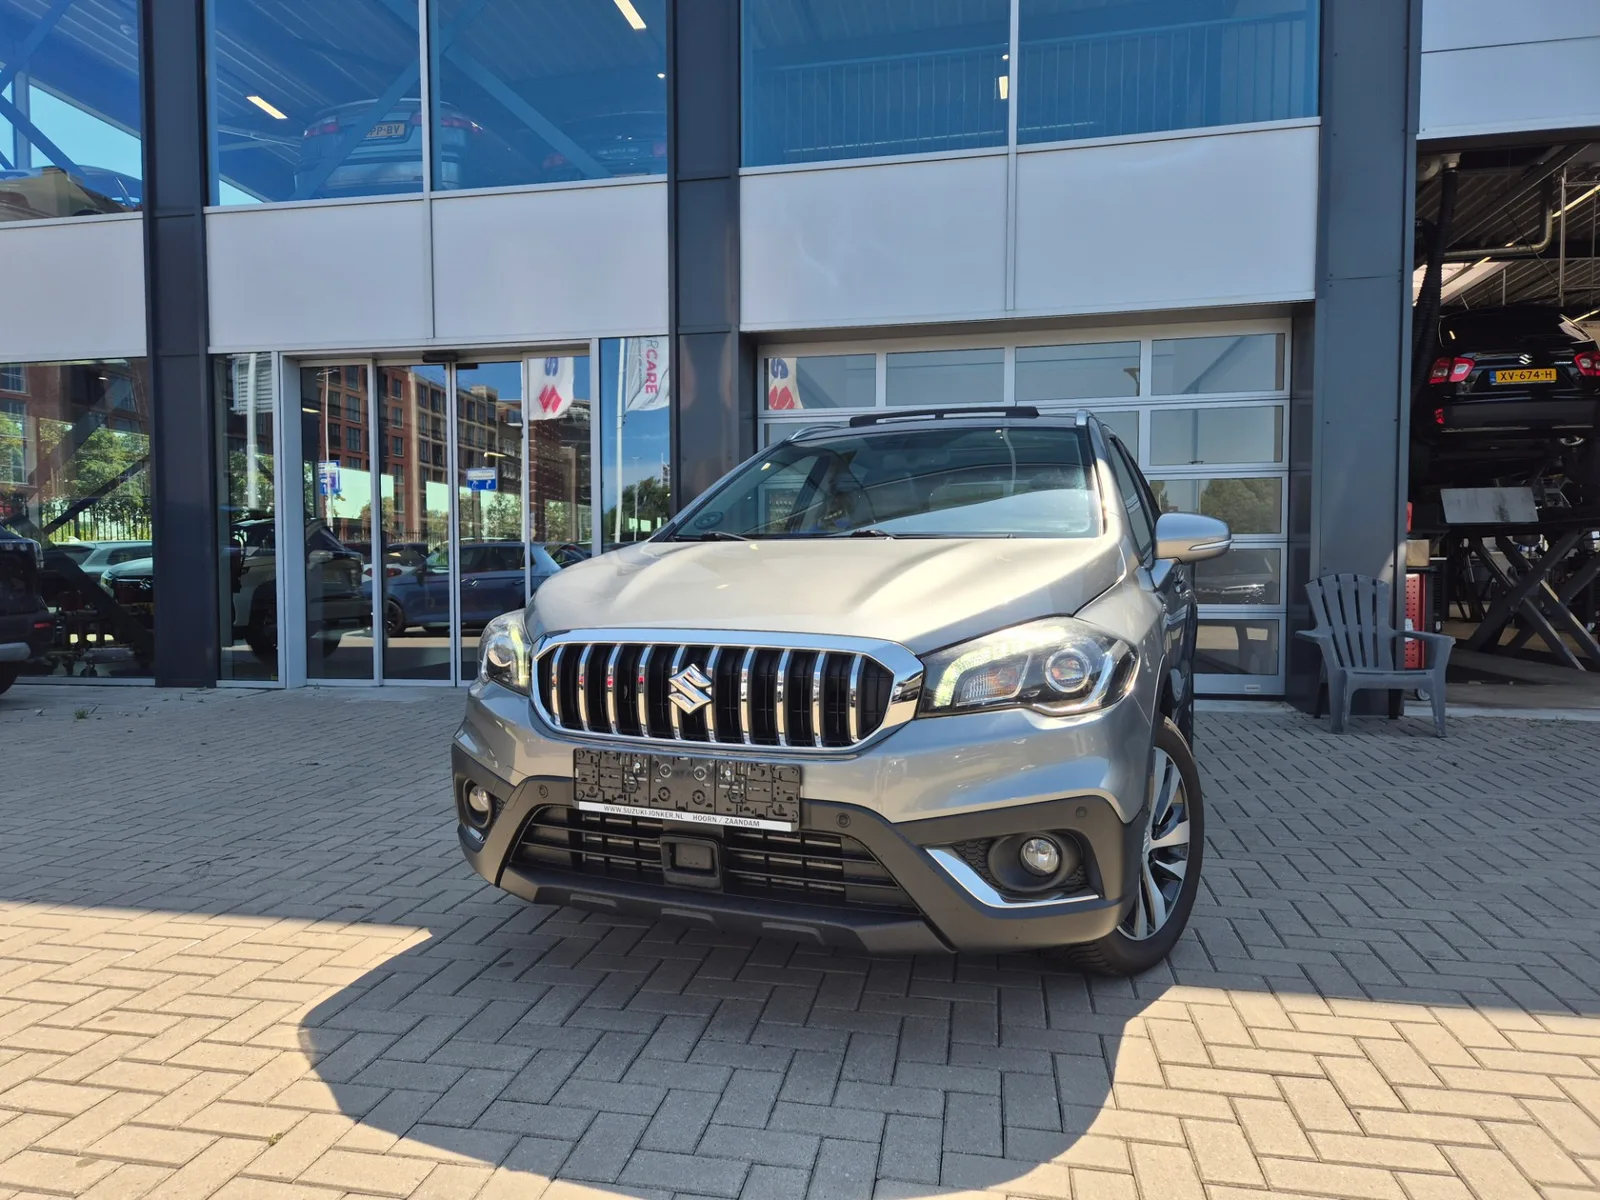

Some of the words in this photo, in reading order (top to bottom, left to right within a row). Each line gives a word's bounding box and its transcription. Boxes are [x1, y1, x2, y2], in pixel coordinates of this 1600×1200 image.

[1500, 370, 1553, 381] XV-674-H
[603, 805, 684, 820] WWW.SUZUKI-JONKER.NL
[692, 814, 717, 823] HOORN
[724, 817, 760, 828] ZAANDAM
